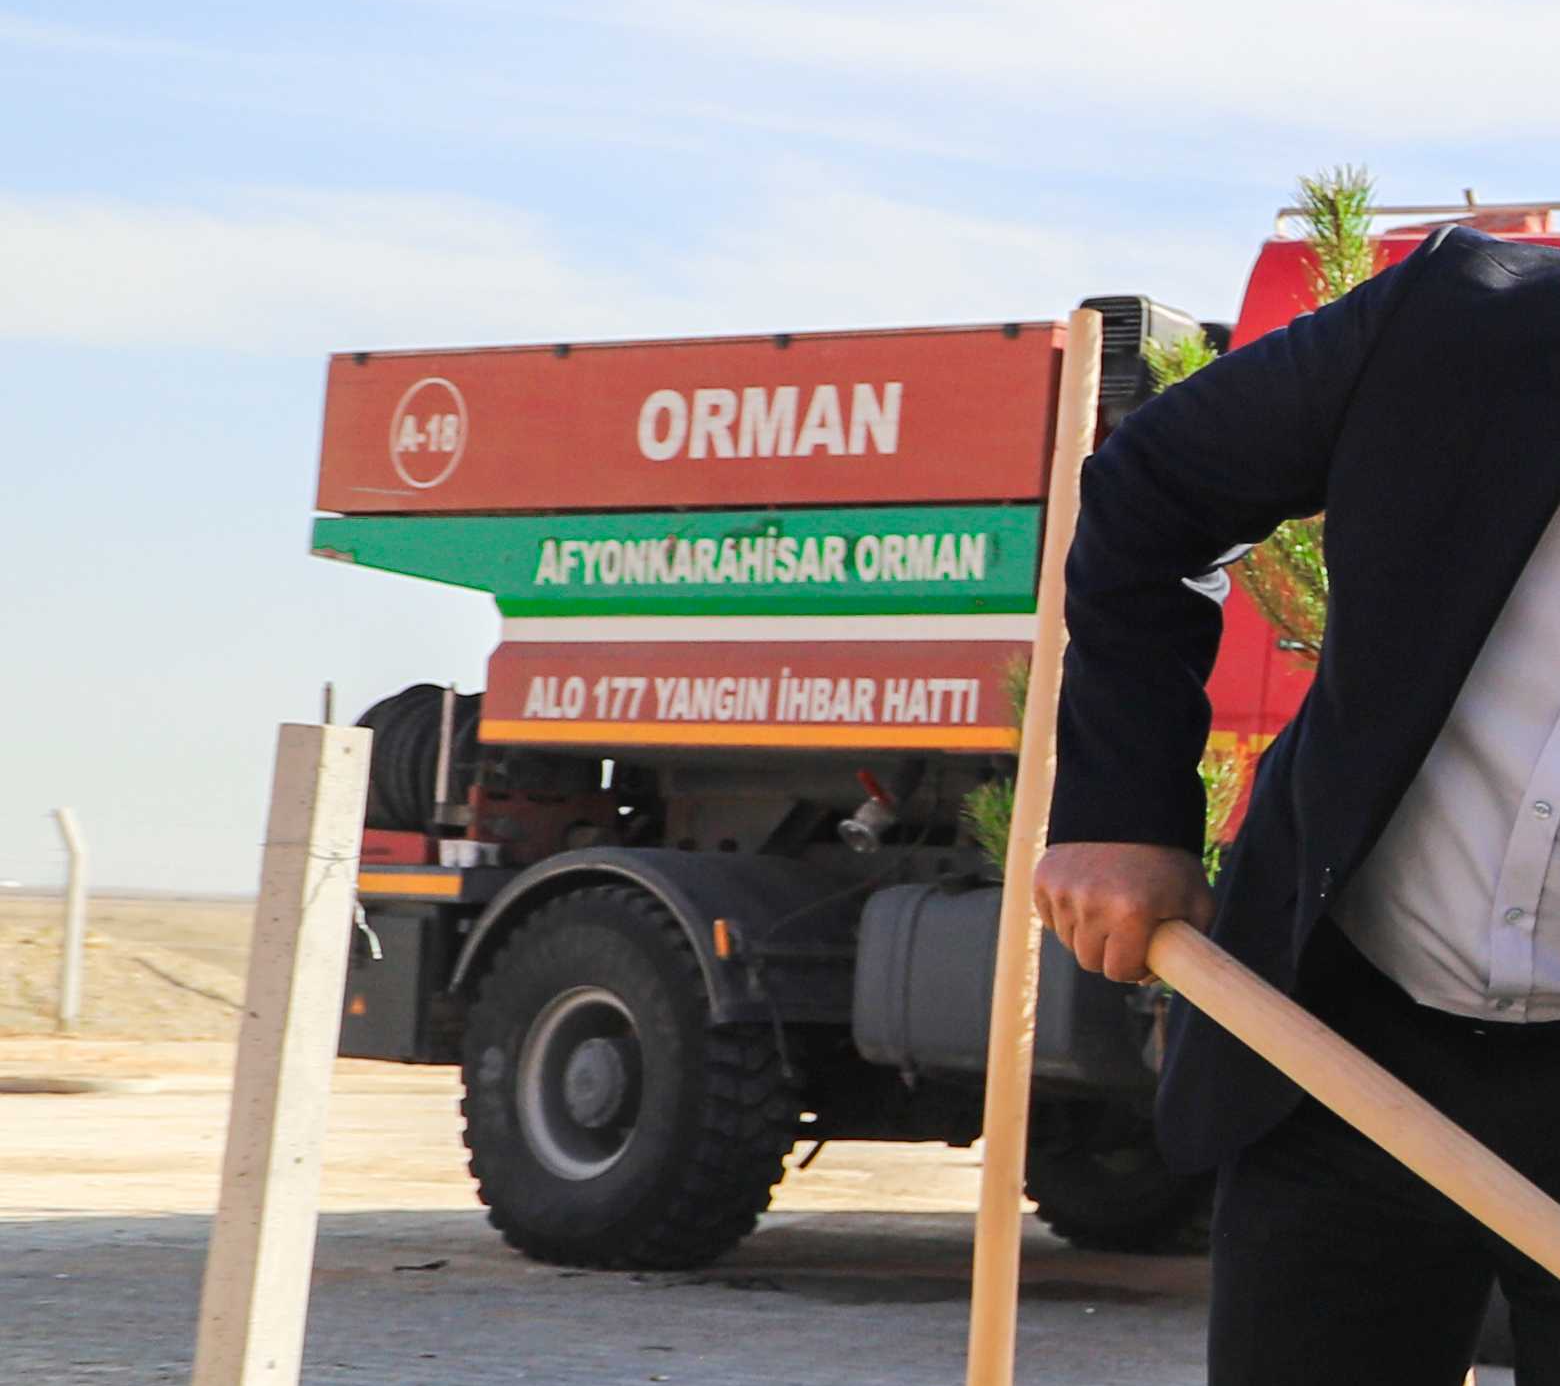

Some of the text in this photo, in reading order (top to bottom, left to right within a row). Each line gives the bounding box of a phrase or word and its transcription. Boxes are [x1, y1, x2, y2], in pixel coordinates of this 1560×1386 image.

[399, 413, 460, 453] A-18
[637, 382, 903, 461] ORMAN
[533, 526, 987, 585] AFYONKARAHİSAR ORMAN
[523, 667, 980, 725] ALO 177 YANGIN İHBAR HATTI
